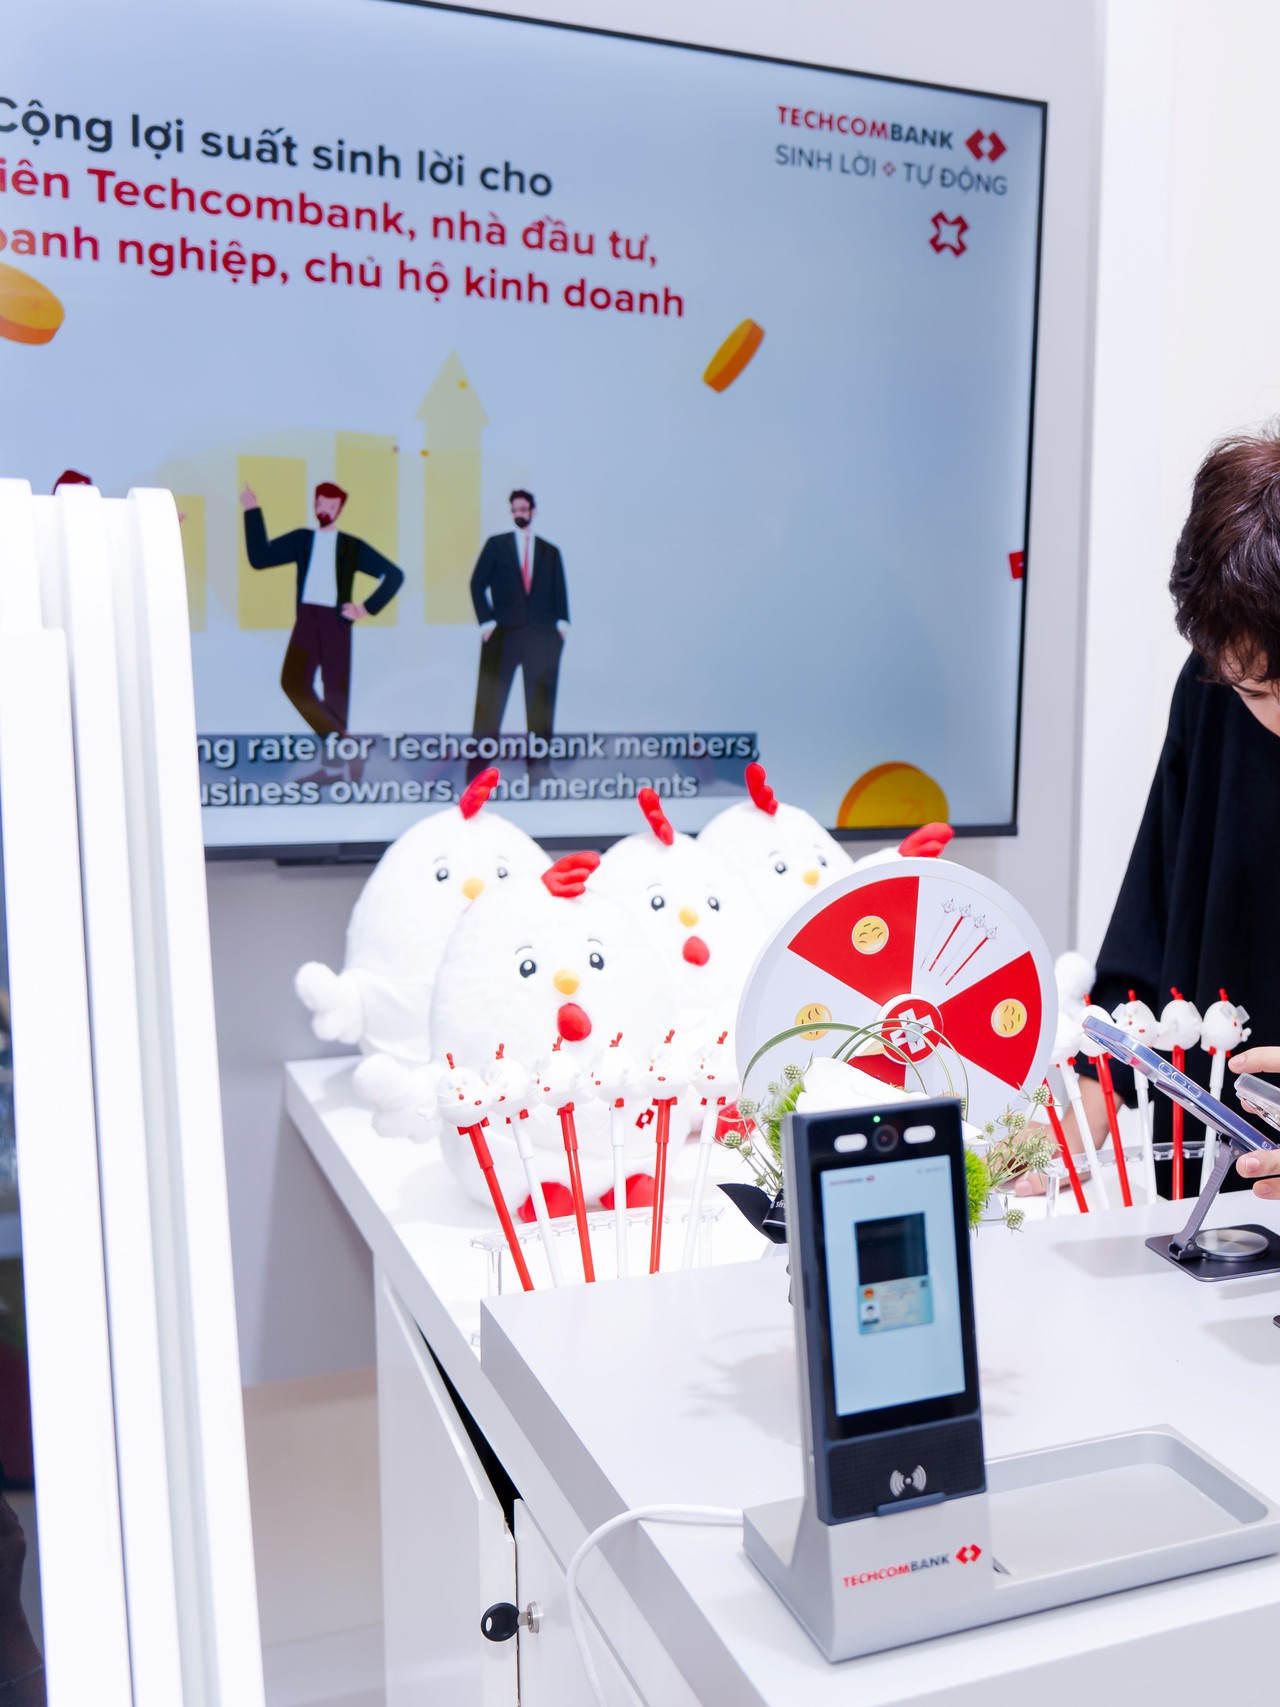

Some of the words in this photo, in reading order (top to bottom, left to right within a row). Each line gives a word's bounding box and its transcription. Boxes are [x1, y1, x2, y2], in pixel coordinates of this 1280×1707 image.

[777, 105, 954, 150] TECHCOMBANK
[131, 113, 183, 160] lợi
[201, 127, 298, 167] suất
[312, 139, 401, 179] sinh
[418, 149, 464, 186] lời
[480, 161, 553, 197] cho
[775, 144, 832, 172] SINH
[839, 150, 877, 178] LỜI
[902, 161, 934, 189] TỰ
[940, 165, 1008, 197] ĐỘNG
[87, 168, 416, 241] Techcombank,
[432, 210, 506, 246] nhà
[521, 214, 595, 256] đầu
[608, 230, 658, 268] tư,
[118, 236, 289, 286] nghiệp,
[304, 251, 381, 288] chủ
[399, 258, 450, 304] hộ
[465, 266, 549, 305] kinh
[563, 278, 684, 318] doanh
[248, 737, 316, 761] rate
[325, 732, 373, 761] for
[383, 731, 606, 761] Techcombank
[615, 734, 760, 762] members,
[330, 778, 460, 804] owners,
[490, 772, 530, 800] nd
[843, 1553, 950, 1588] TECHCOMBANK
